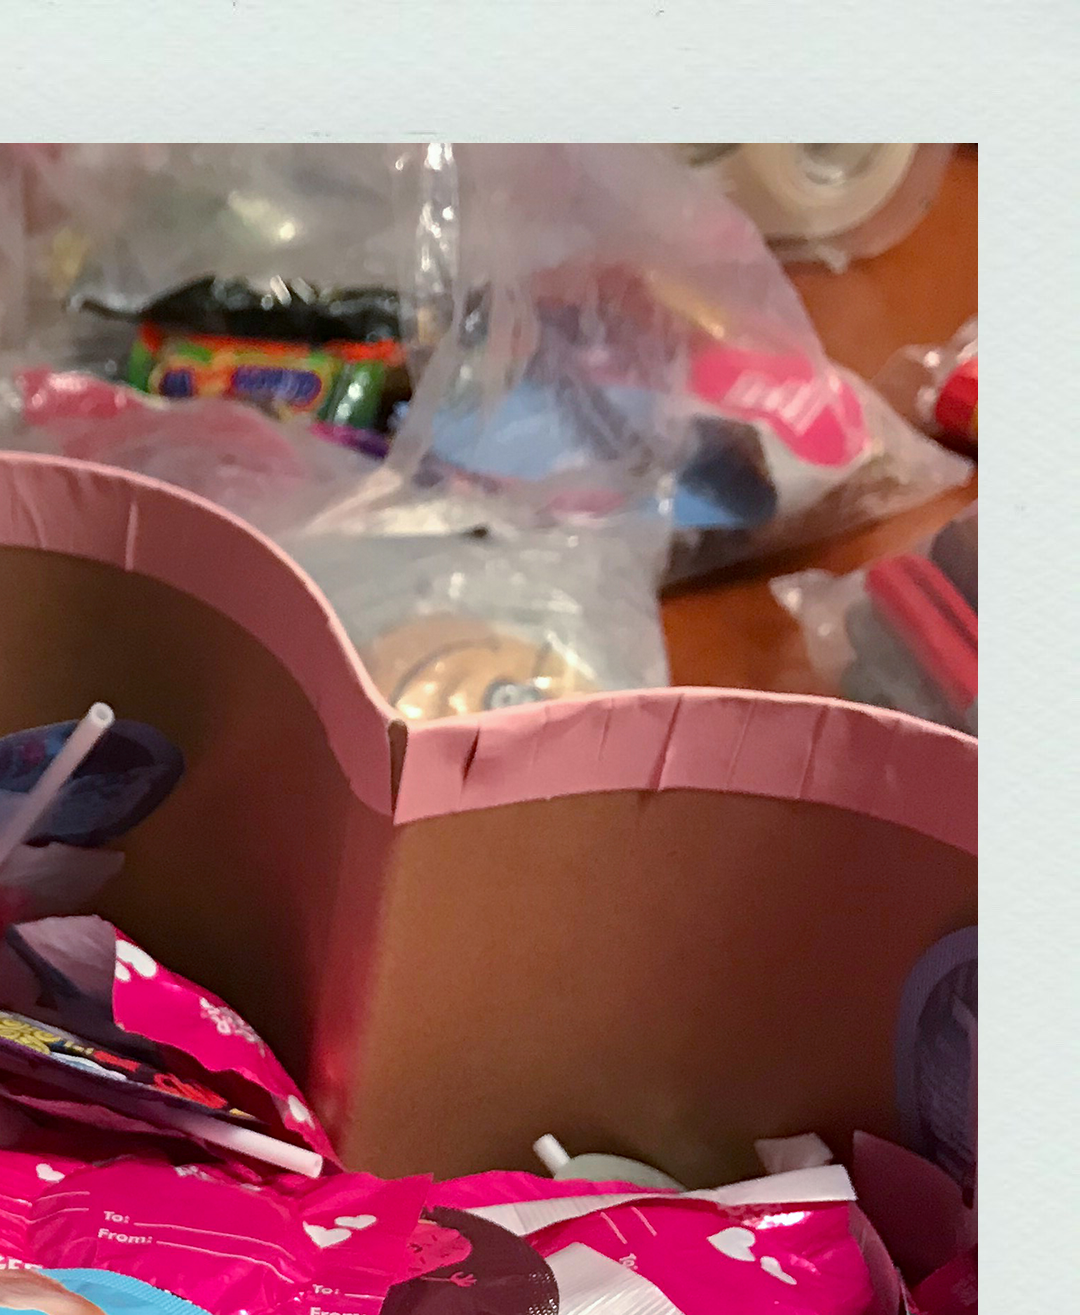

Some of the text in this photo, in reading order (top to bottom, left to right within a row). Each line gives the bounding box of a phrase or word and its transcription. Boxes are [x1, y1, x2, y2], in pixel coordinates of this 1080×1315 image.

[103, 1210, 130, 1223] To:
[98, 1228, 153, 1244] From:
[312, 1284, 339, 1296] To:
